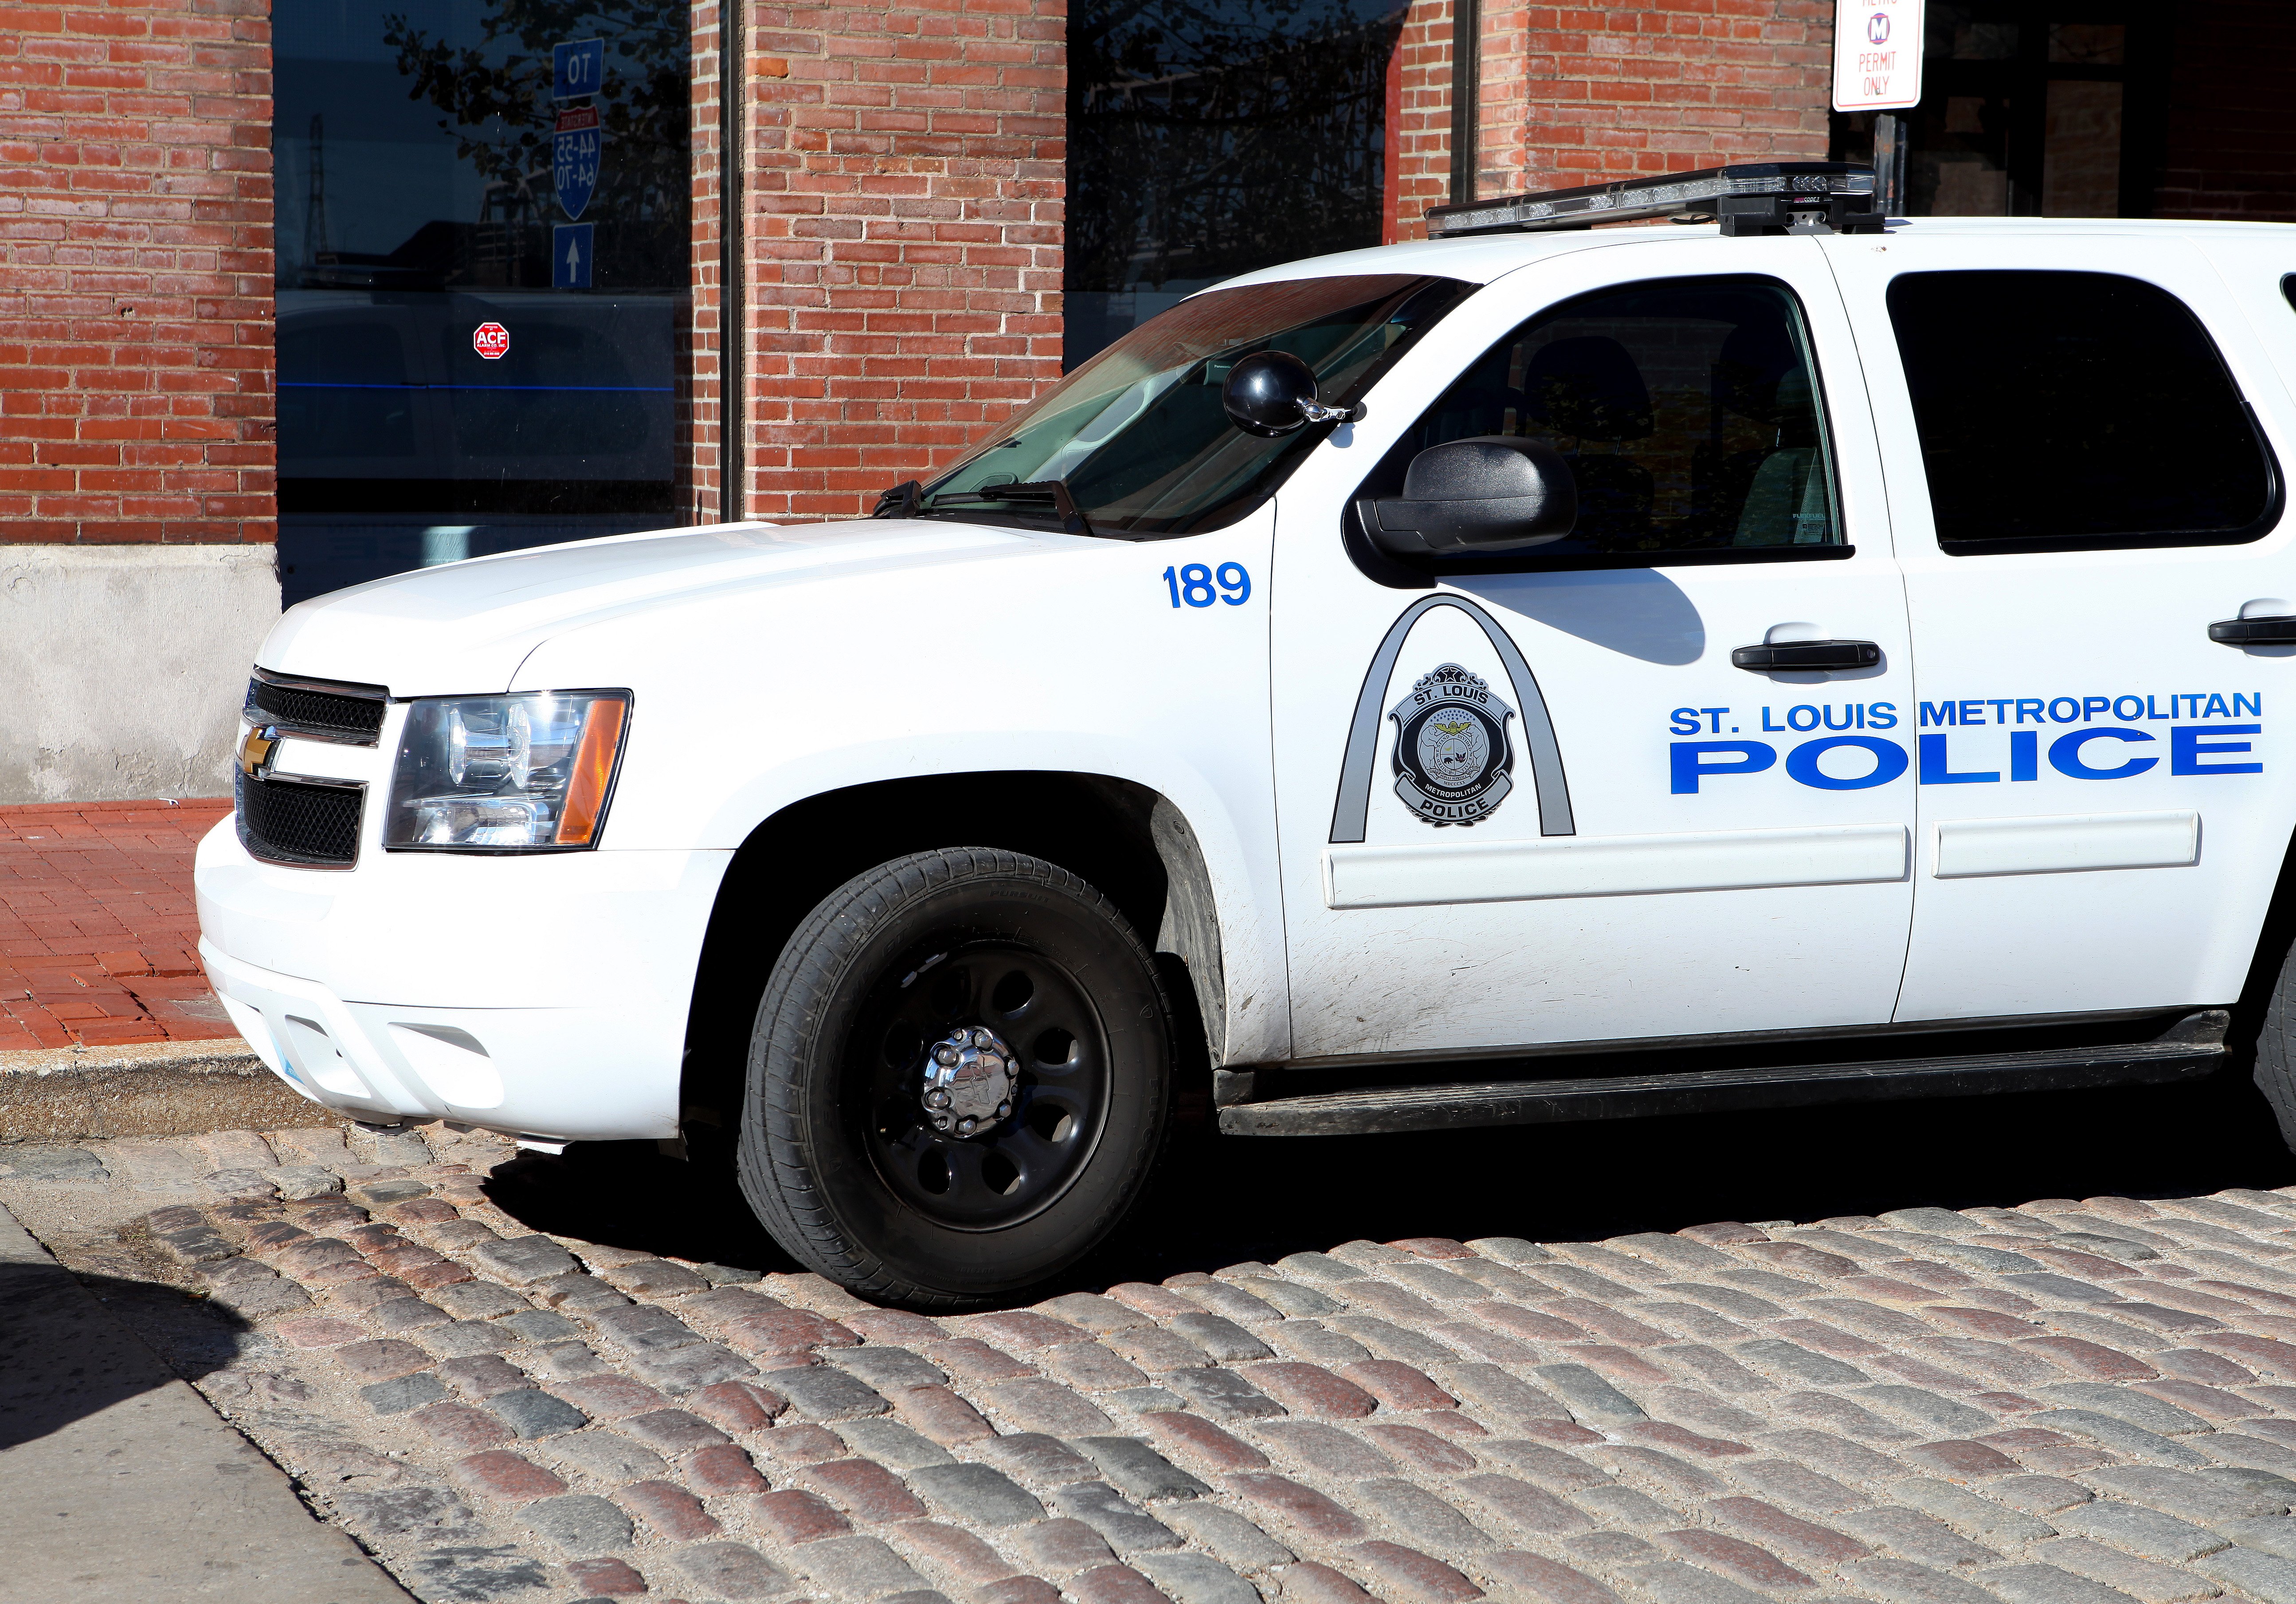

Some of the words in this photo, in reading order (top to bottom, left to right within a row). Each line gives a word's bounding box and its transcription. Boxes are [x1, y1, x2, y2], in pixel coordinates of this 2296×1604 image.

[1859, 51, 1896, 72] PERMIT
[1864, 76, 1890, 96] ONLY
[477, 331, 506, 344] ACF
[1163, 561, 1251, 608] 189
[1414, 689, 1438, 706] ST.
[1443, 685, 1489, 704] LOUIS
[1669, 708, 1739, 735] ST.
[1762, 702, 1897, 732] LOUIS
[1920, 692, 2261, 727] METROPOLITAN
[1670, 724, 2263, 794] POLICE
[1425, 783, 1482, 798] METROPOLITAN
[1419, 797, 1489, 818] POLICE
[989, 889, 1050, 904] PURSUIT
